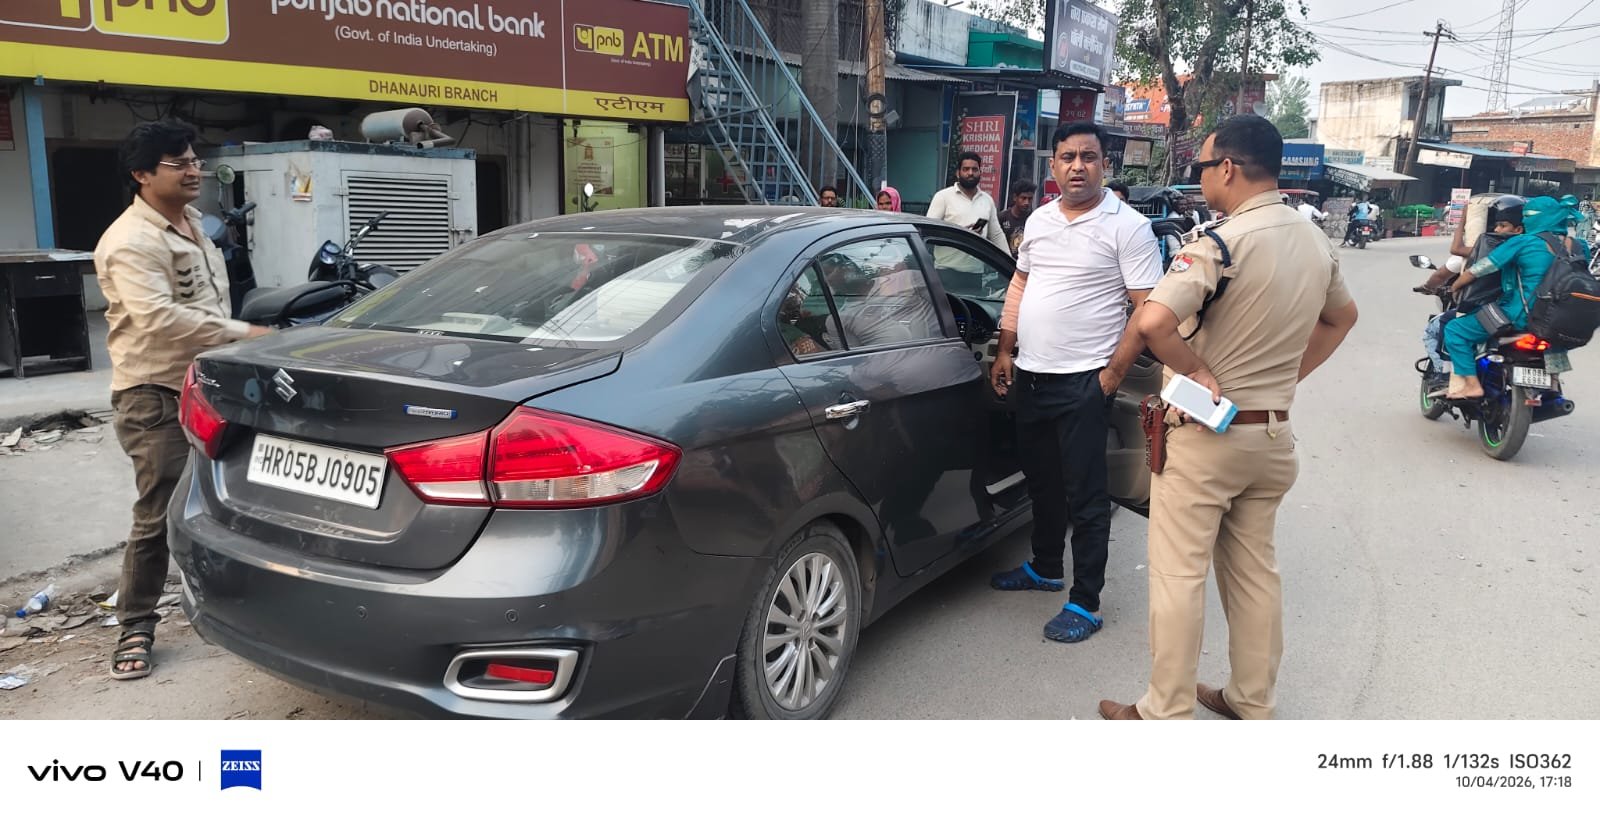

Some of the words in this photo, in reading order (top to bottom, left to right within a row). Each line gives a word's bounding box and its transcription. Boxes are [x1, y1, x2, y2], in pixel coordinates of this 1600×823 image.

[376, 0, 484, 31] national
[489, 6, 545, 39] bank
[335, 25, 374, 41] (Govt.
[378, 31, 390, 42] of
[393, 32, 423, 46] India
[426, 37, 498, 57] Undertaking)
[596, 32, 622, 50] pnb
[631, 31, 684, 63] ATM
[369, 79, 441, 98] DHANAURI
[445, 86, 498, 102] BRANCH
[594, 96, 665, 113] एटीएम
[966, 120, 1000, 132] SHRI
[962, 133, 1000, 142] KRISHNA
[962, 144, 999, 152] MEDICAL
[1281, 155, 1320, 166] SAMSUNG
[261, 443, 381, 495] HR05BJ0905
